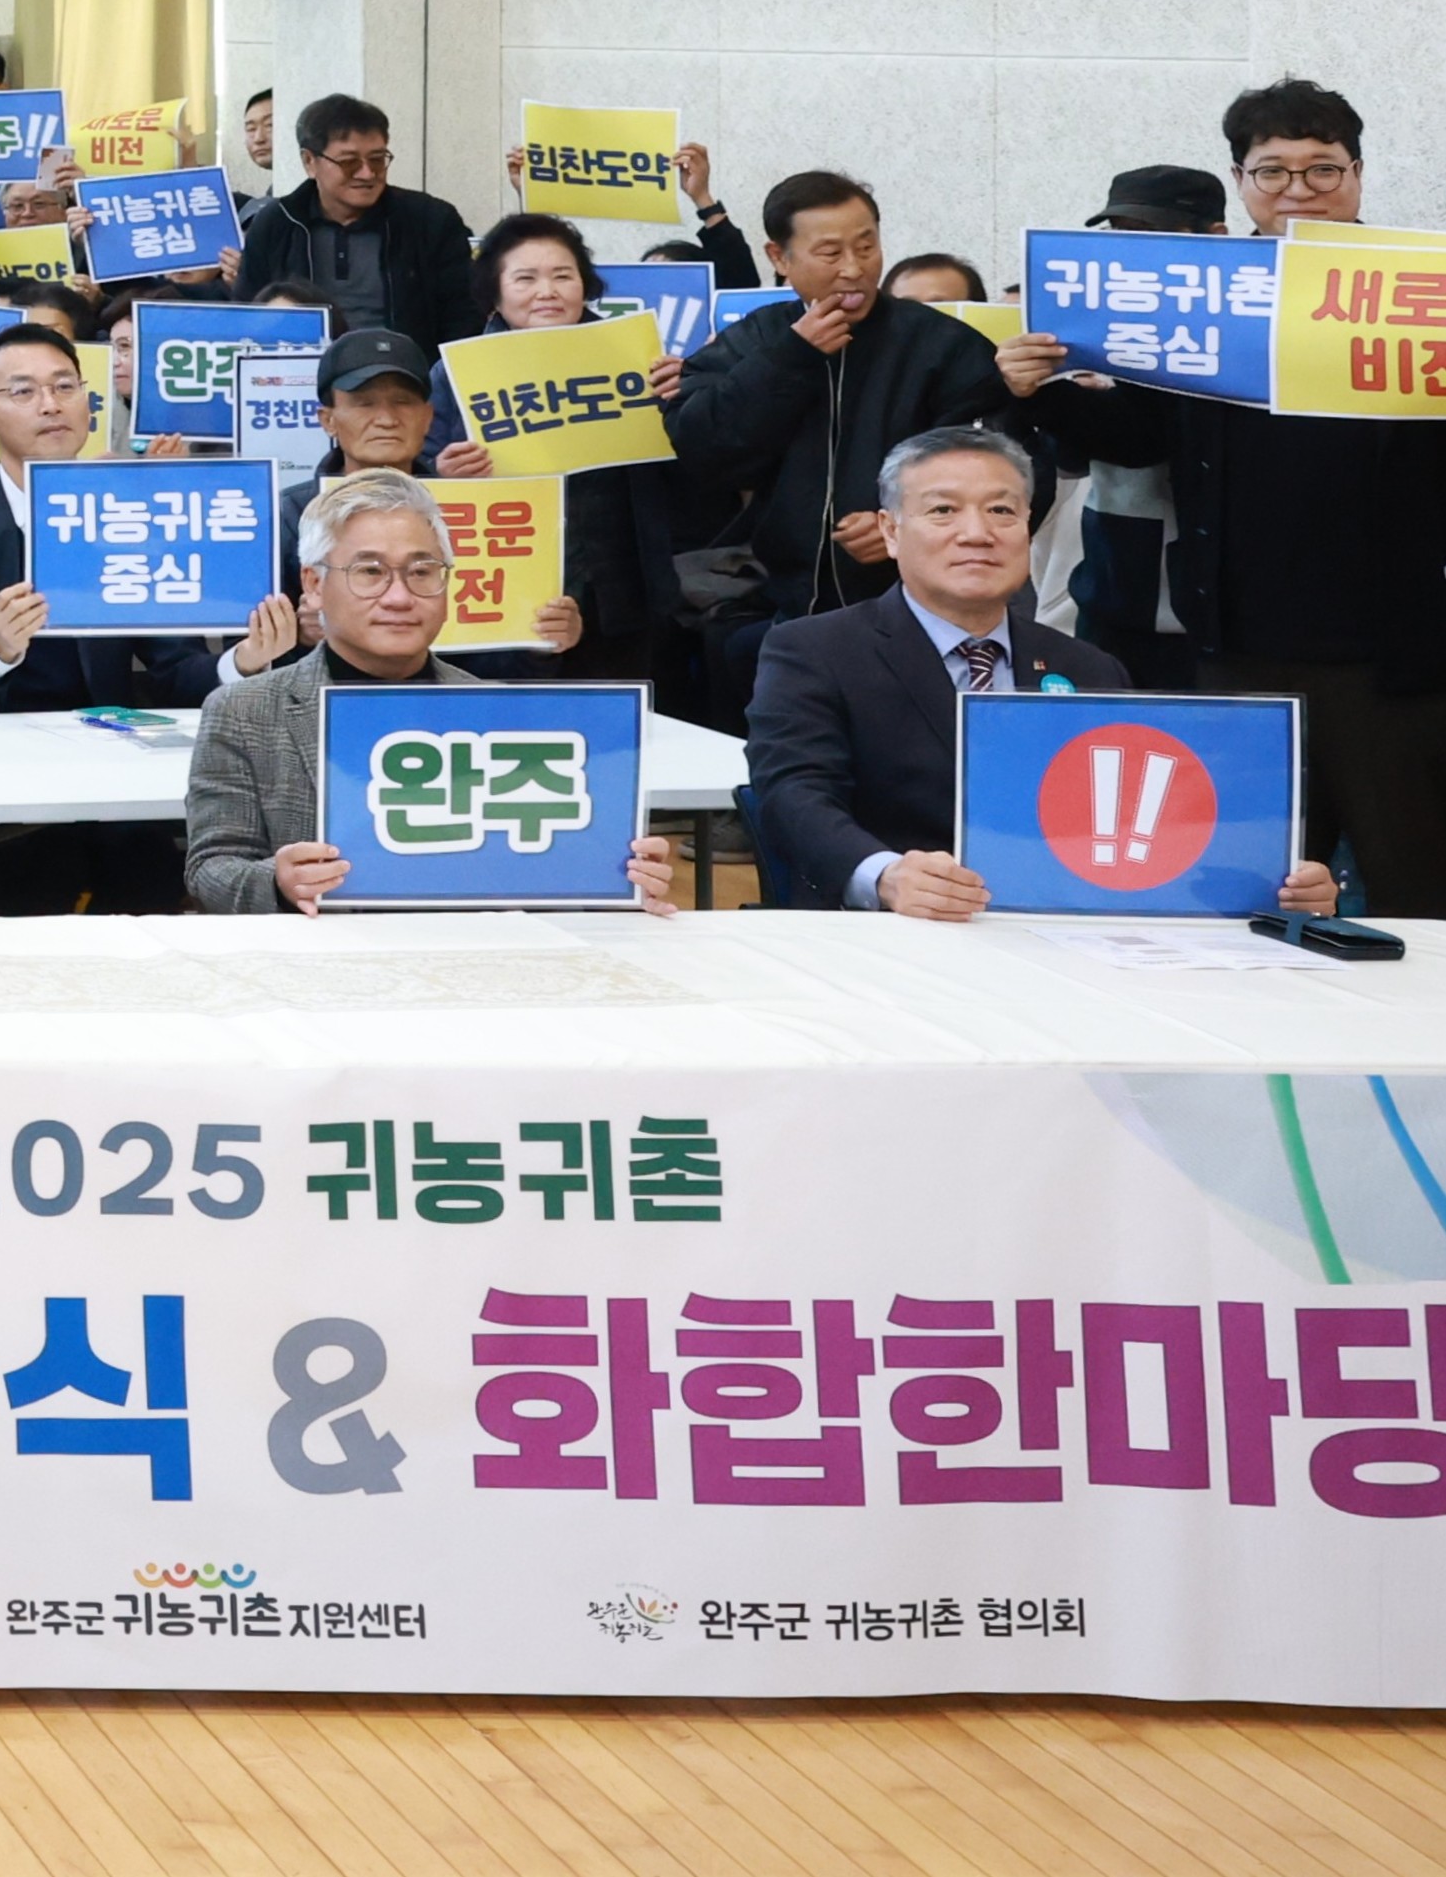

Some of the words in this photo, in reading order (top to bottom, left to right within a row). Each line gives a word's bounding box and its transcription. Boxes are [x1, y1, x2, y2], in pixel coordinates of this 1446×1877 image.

[80, 105, 162, 134] 새로운
[90, 137, 145, 168] 비전
[525, 142, 671, 191] 힘찬도약
[90, 183, 222, 227] 귀농귀촌
[130, 225, 197, 261] 중심
[1043, 259, 1276, 318] 귀농귀촌
[1103, 323, 1221, 377] 중심
[46, 488, 259, 545] 귀농귀촌
[100, 553, 203, 606] 중심
[377, 738, 582, 846] 완주
[304, 1114, 725, 1225] 귀농귀촌
[265, 1314, 409, 1497] &
[470, 1286, 1446, 1519] 화합한마당
[5, 1598, 107, 1636] 완주군
[111, 1591, 283, 1638] 귀농귀촌
[287, 1601, 428, 1640] 지원센터
[697, 1598, 812, 1642] 완주군
[824, 1597, 965, 1642] 귀농귀촌
[976, 1596, 1087, 1638] 협의회
